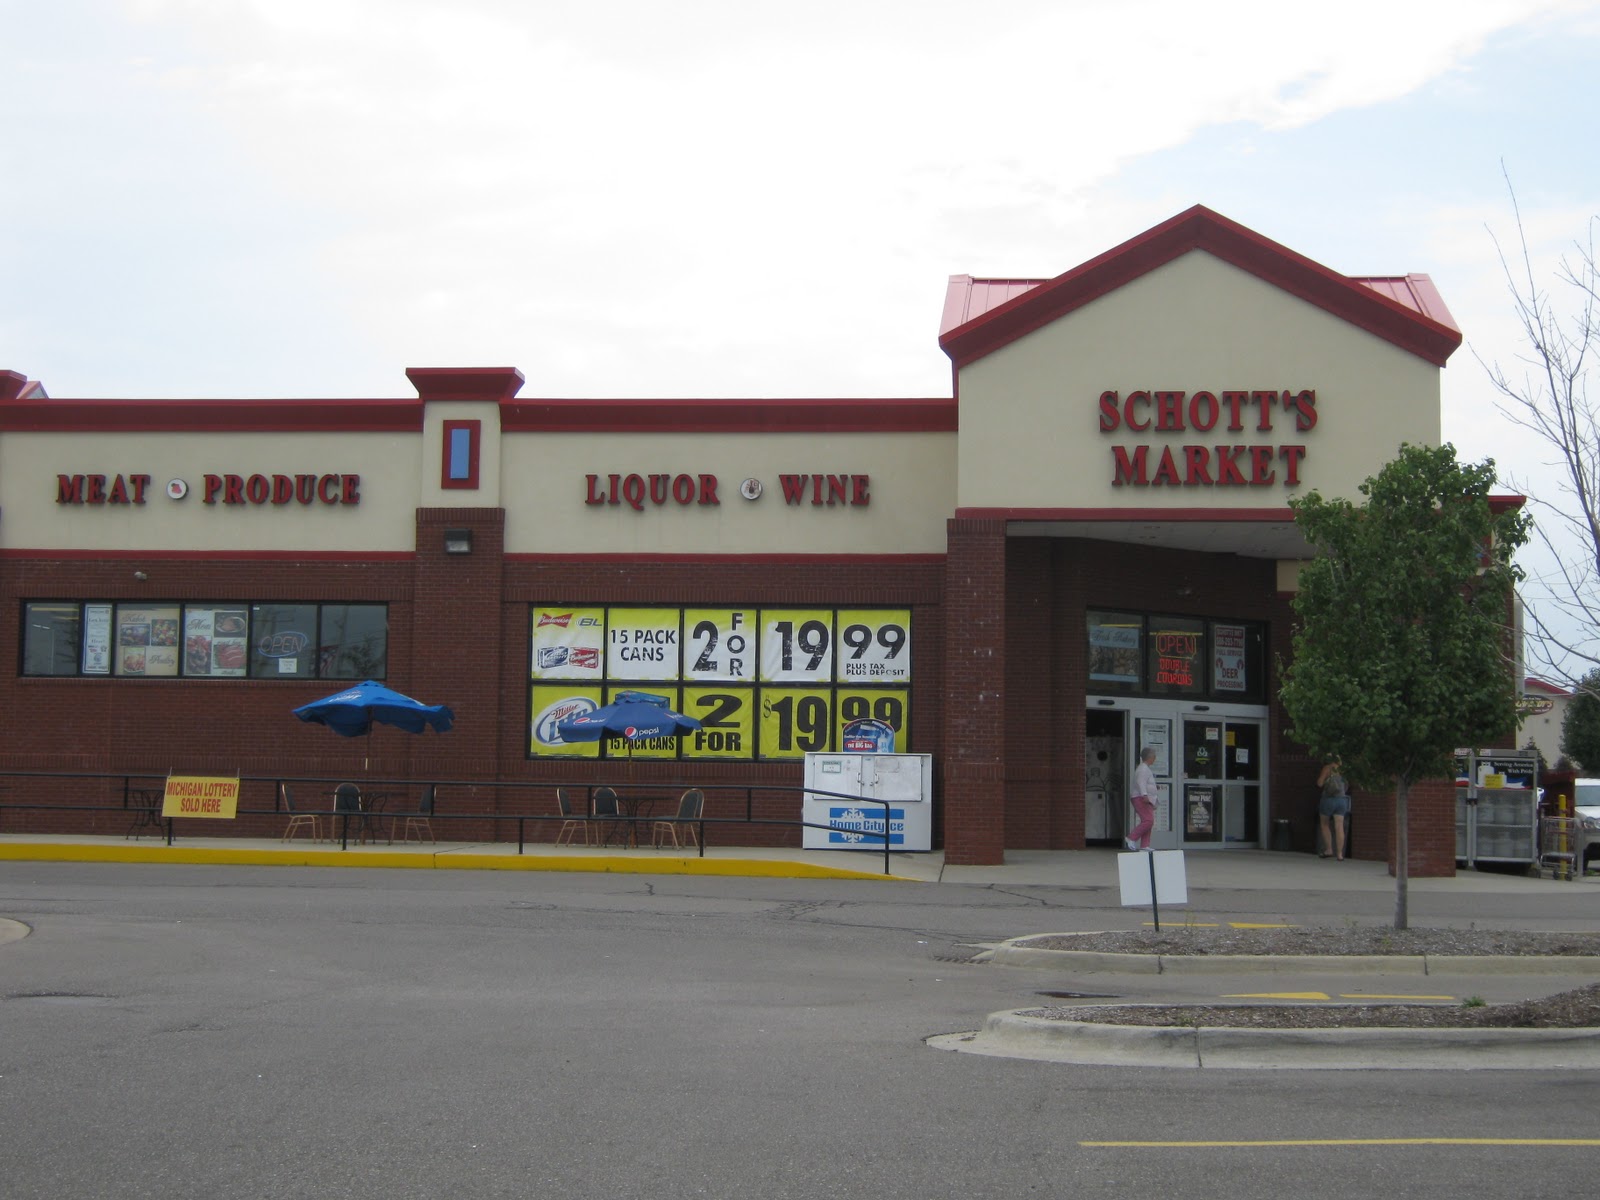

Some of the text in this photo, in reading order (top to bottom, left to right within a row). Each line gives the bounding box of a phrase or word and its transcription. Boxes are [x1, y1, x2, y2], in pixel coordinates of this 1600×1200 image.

[1099, 390, 1318, 432] SCHOTT'S
[1111, 445, 1306, 486] MARKET
[56, 474, 360, 504] MEAT PRODUCE
[585, 474, 870, 511] LIQUOR WINE
[580, 618, 602, 626] BL
[261, 636, 303, 653] OPEN
[611, 630, 676, 644] 15 PACK
[843, 624, 906, 660] 99
[1158, 635, 1194, 654] OPEN
[692, 621, 718, 671] 2
[775, 620, 829, 671] 19
[621, 647, 664, 661] CANS
[1159, 658, 1190, 672] DOUBLE
[1156, 672, 1193, 686] COUPONS
[1222, 668, 1239, 679] DEER
[551, 703, 580, 719] Miller
[696, 694, 743, 728] 2
[638, 727, 660, 736] pepsi
[610, 737, 675, 750] 15 PACK CANS
[695, 731, 741, 751] FOR
[166, 782, 237, 797] MICHIGAN LOTTERY
[180, 798, 221, 813] SOLD HERE
[829, 820, 861, 831] Home
[863, 821, 884, 832] City
